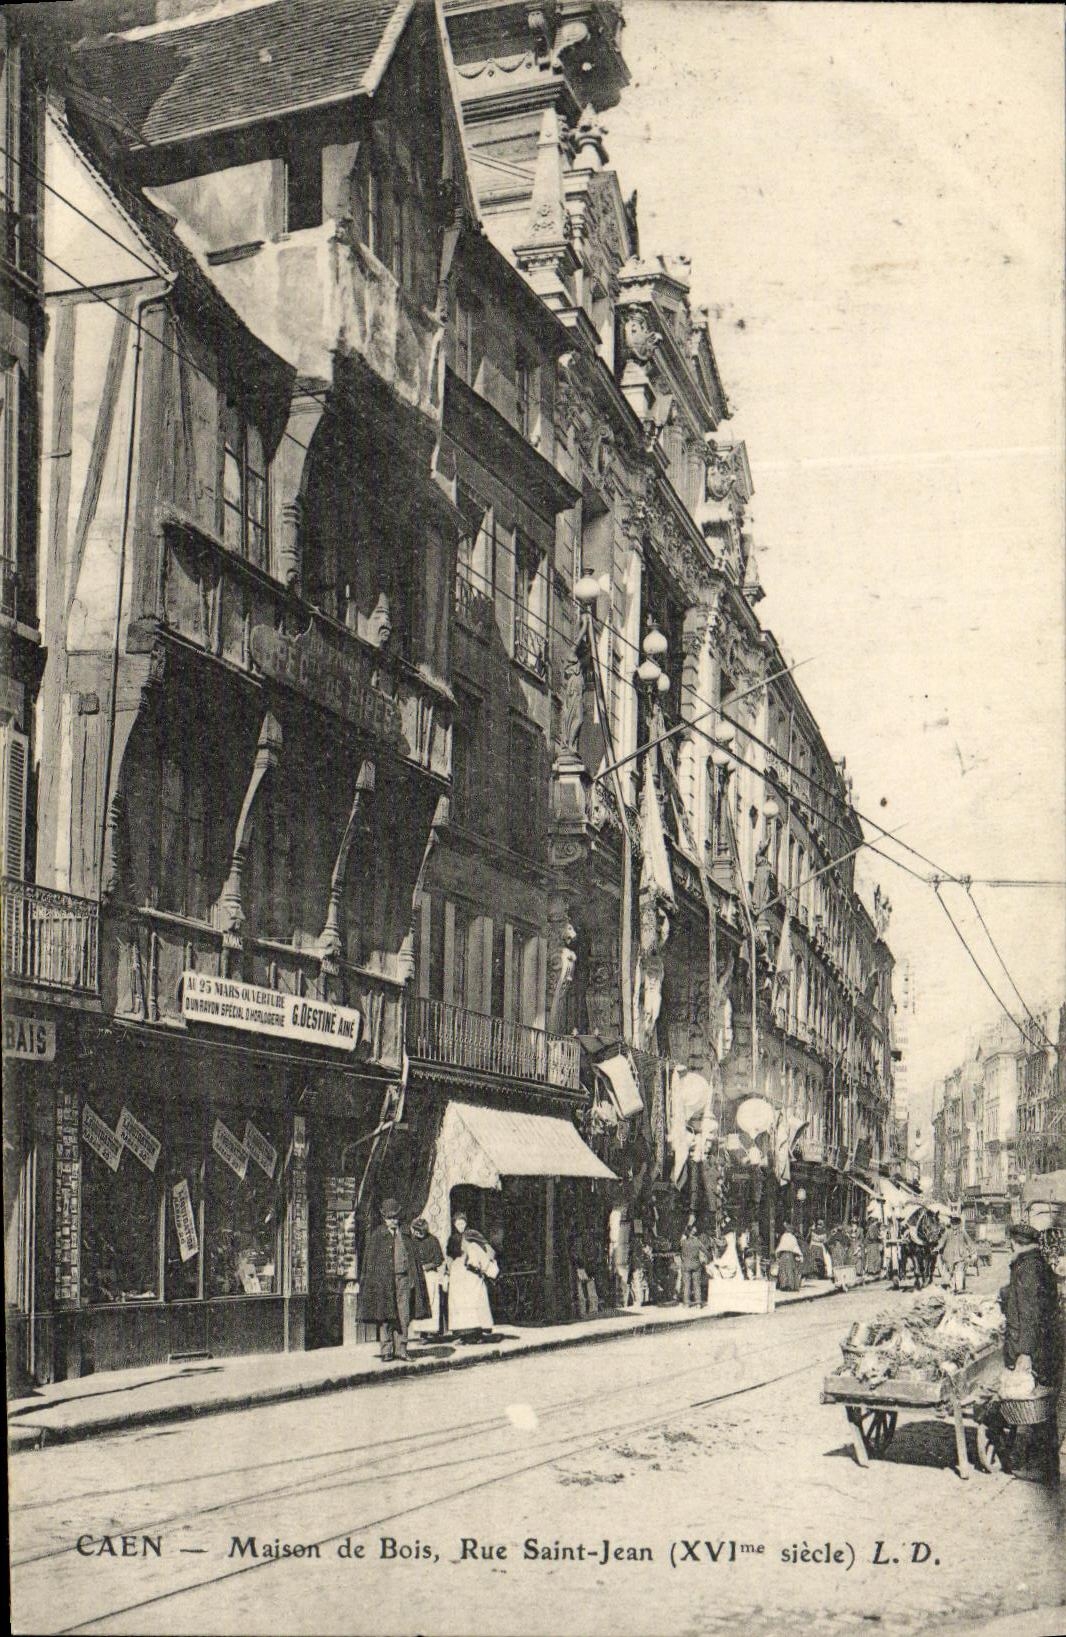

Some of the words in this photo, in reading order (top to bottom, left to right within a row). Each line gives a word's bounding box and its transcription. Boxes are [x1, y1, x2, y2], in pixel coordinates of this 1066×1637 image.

[188, 977, 196, 991] AU
[200, 980, 212, 994] 25
[215, 982, 240, 999] MARS
[241, 989, 285, 1009] OUVERTURE
[199, 1000, 219, 1016] RAYON
